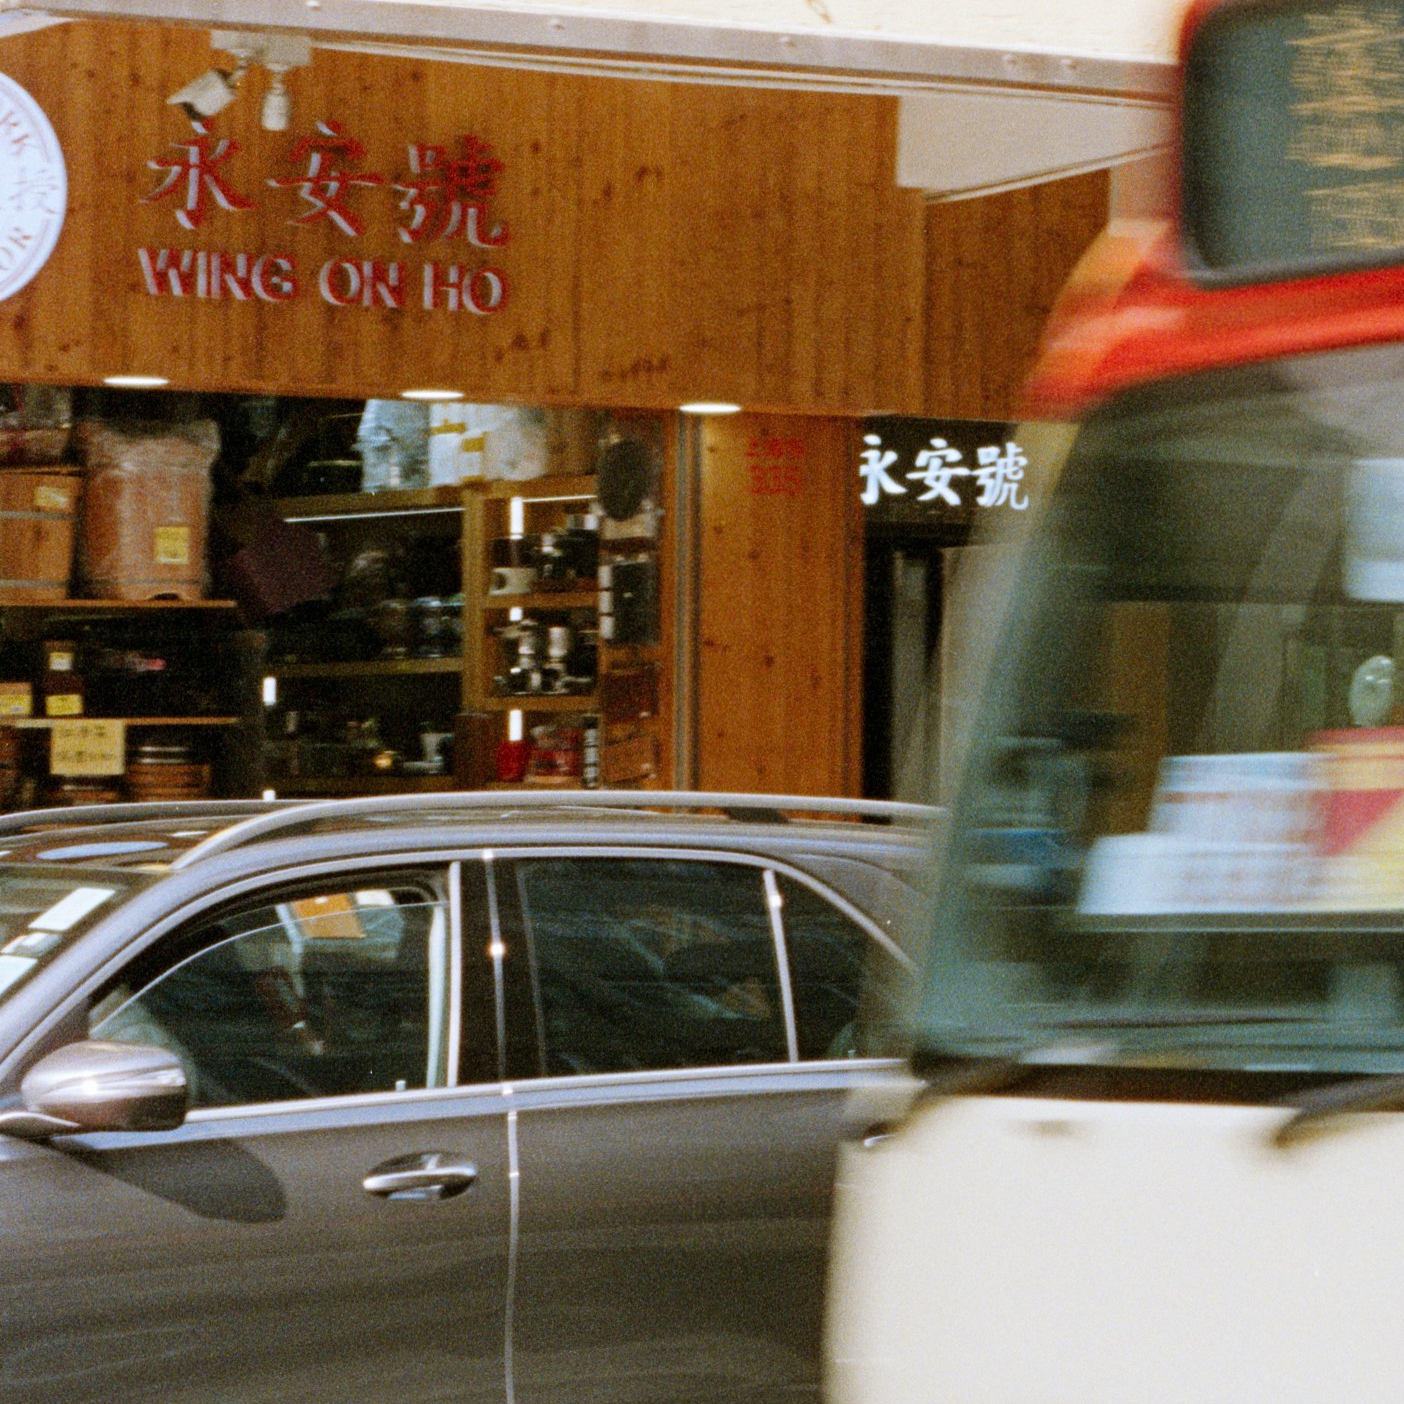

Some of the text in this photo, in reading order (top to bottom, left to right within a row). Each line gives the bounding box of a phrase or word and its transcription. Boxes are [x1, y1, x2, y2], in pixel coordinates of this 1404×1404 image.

[138, 118, 509, 248] 永安號
[138, 247, 508, 316] WING ON HO
[859, 433, 1030, 511] 永安號
